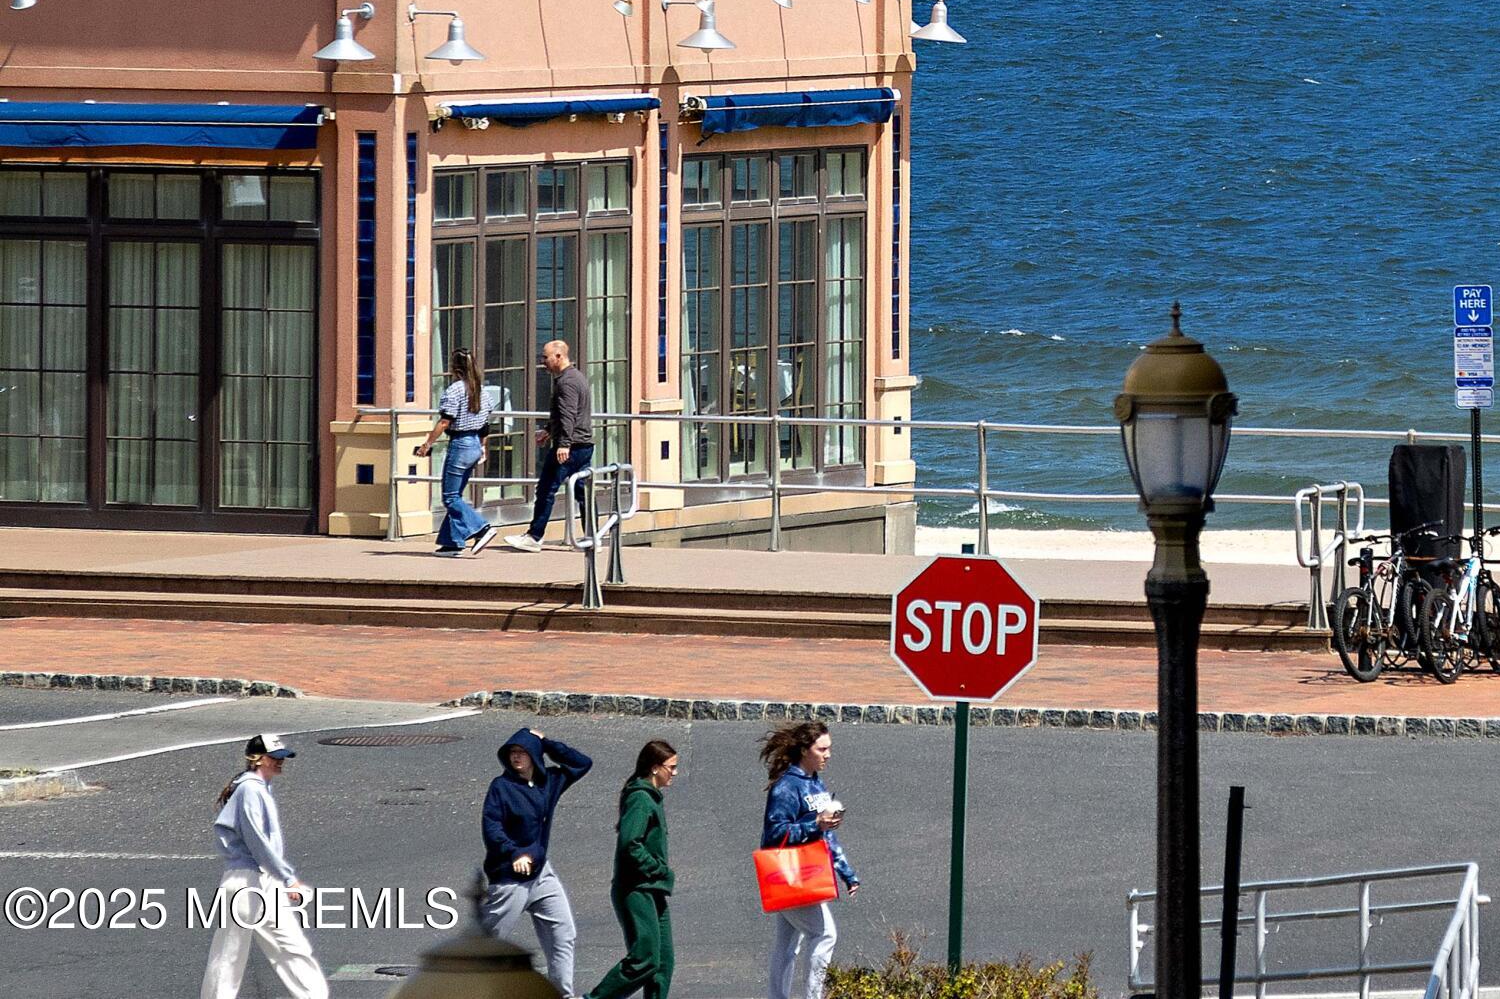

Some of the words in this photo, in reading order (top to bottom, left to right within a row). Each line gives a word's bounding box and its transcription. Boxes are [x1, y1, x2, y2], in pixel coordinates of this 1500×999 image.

[1463, 289, 1482, 298] PAY
[1460, 299, 1487, 308] HERE
[902, 599, 1028, 656] STOP
